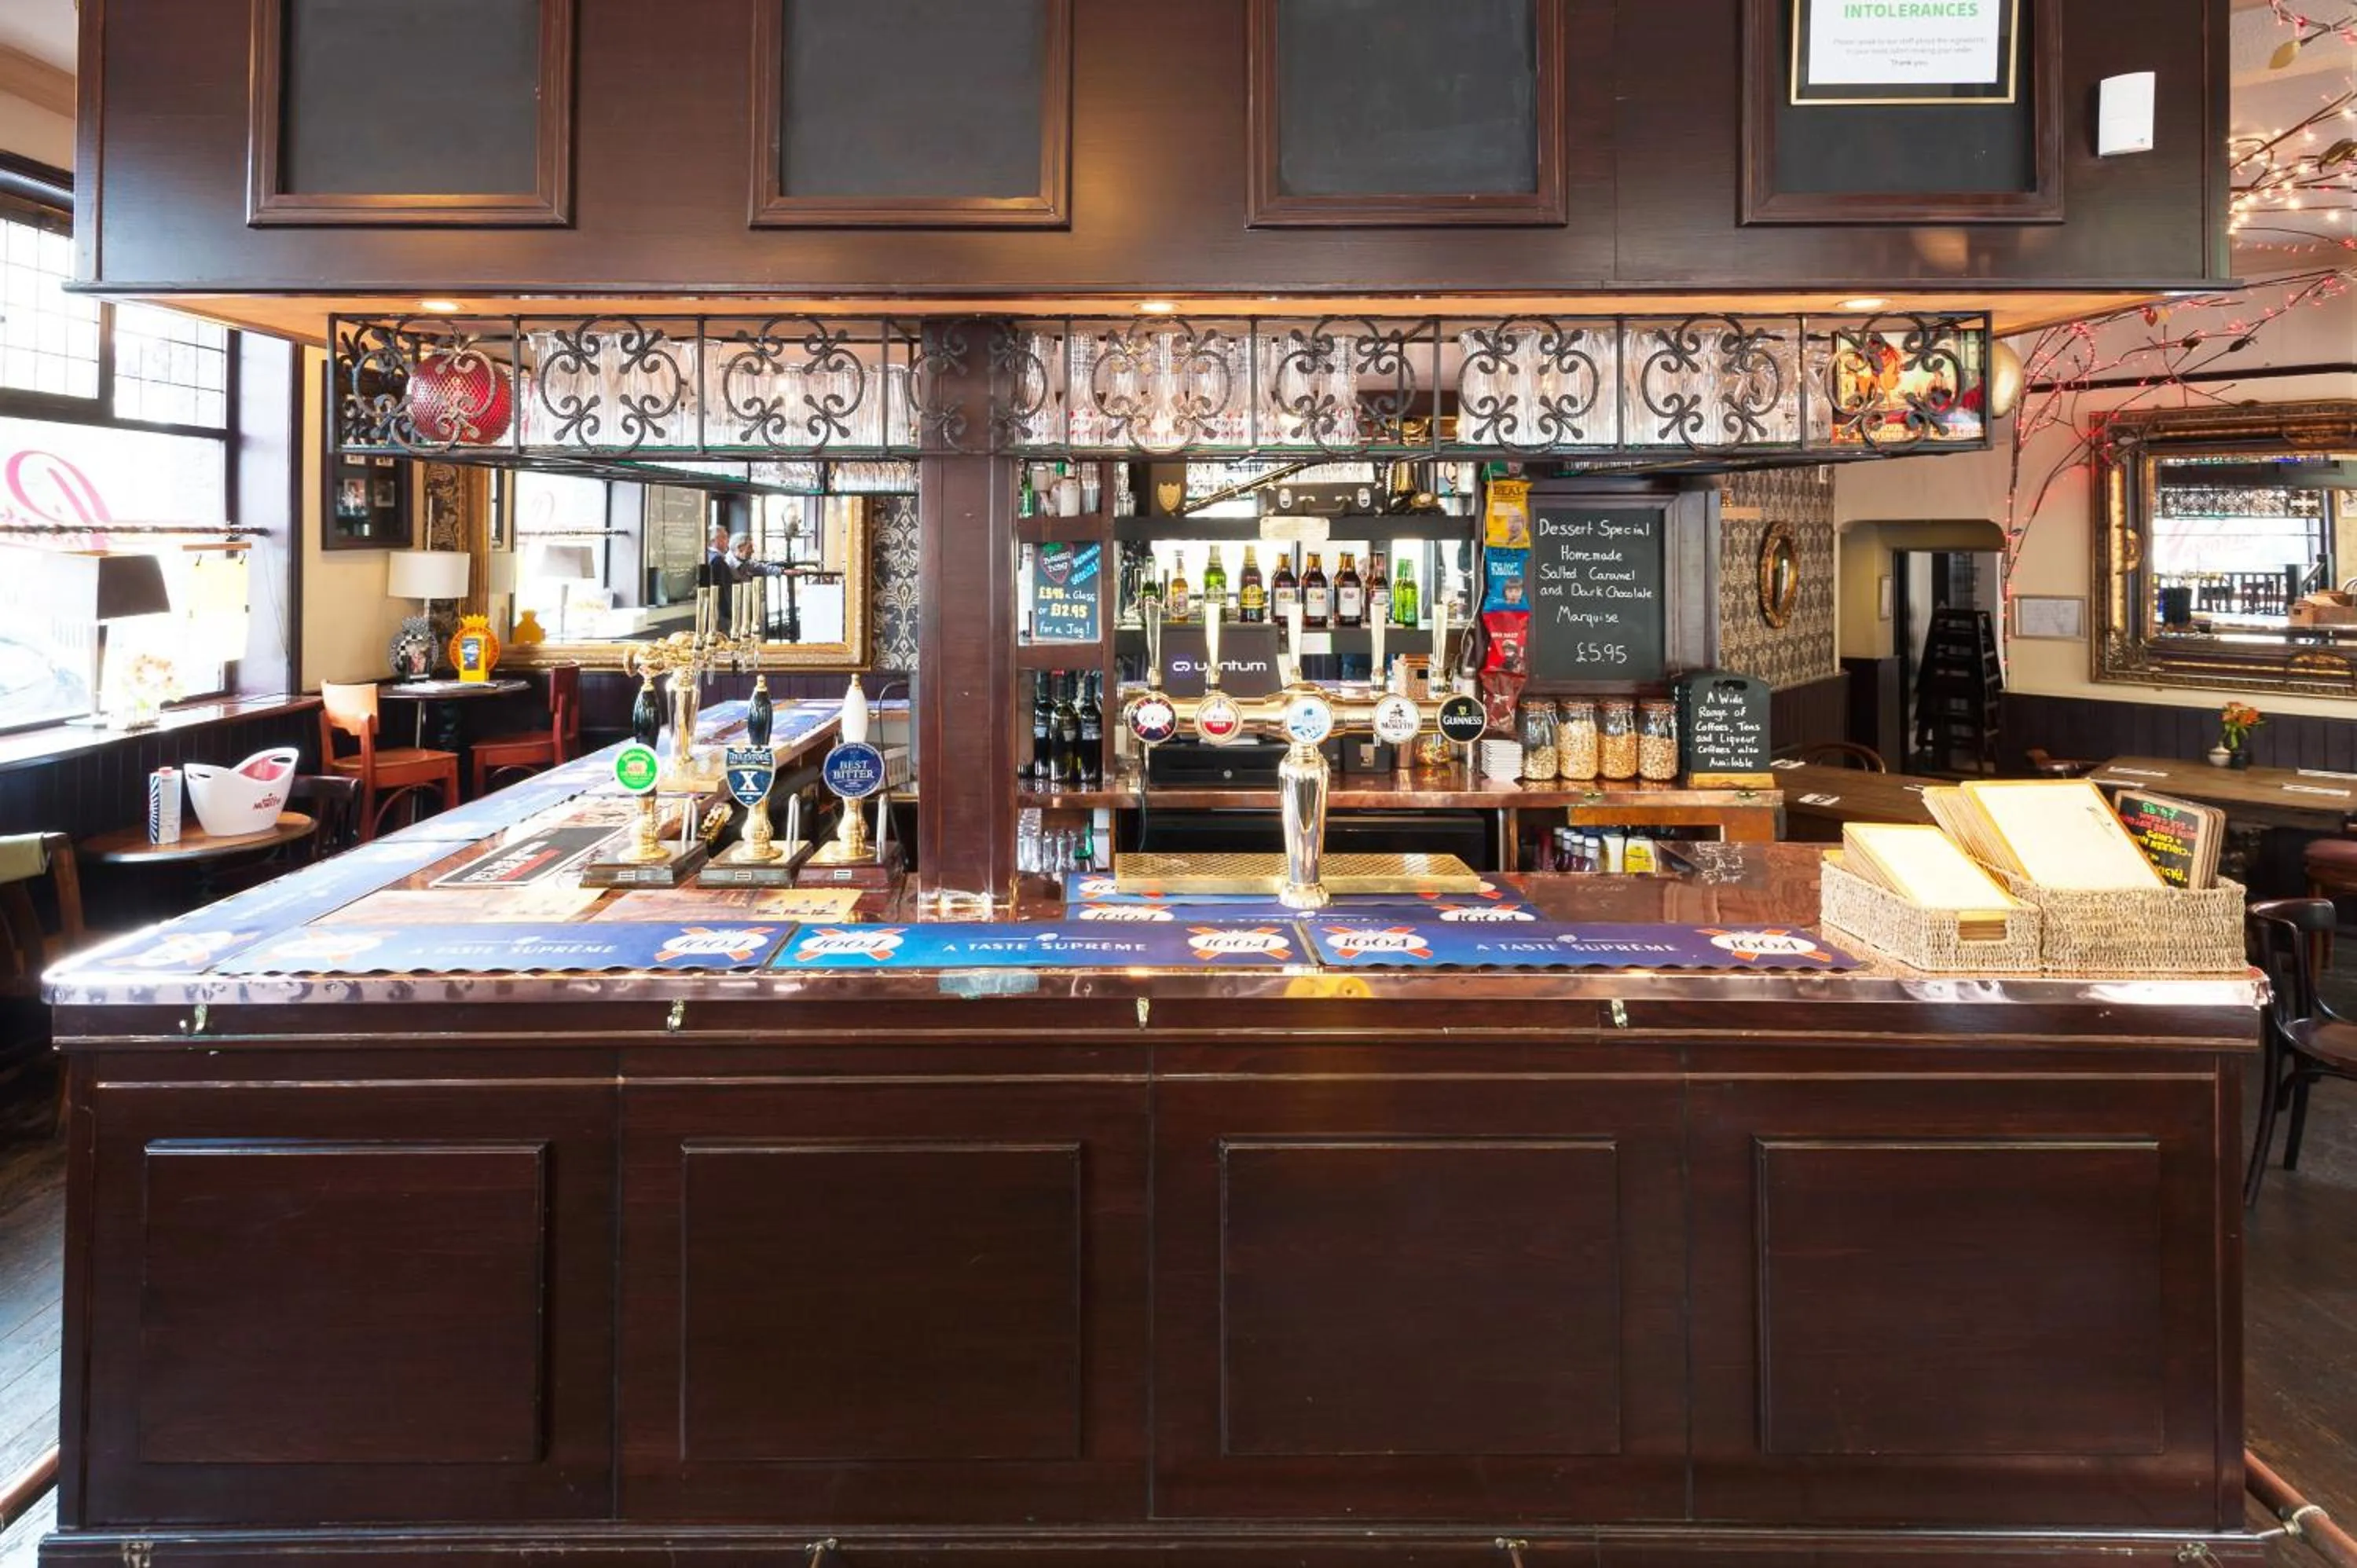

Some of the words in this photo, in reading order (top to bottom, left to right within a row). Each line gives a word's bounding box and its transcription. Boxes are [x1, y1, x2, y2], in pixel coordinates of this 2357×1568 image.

[1844, 2, 1978, 18] INTOLERANCES
[1538, 518, 1593, 537] Dessert
[1597, 519, 1650, 540] Special
[1560, 544, 1622, 562] Homemade
[1539, 563, 1577, 580] Salted
[1589, 566, 1635, 581] Caramel
[1072, 590, 1096, 603] Glass
[1540, 585, 1563, 597] and
[1571, 583, 1603, 597] Dark
[1606, 585, 1653, 599] Chocolate
[1556, 606, 1619, 628] Marquise
[1039, 620, 1054, 634] for
[1575, 642, 1627, 665] £5.95
[1172, 660, 1267, 672] Quntum
[1706, 691, 1715, 703] A
[1718, 692, 1743, 705] Wide
[1442, 715, 1483, 725] GUINNESS
[1698, 706, 1728, 722] Range
[1734, 706, 1747, 717] of
[1736, 721, 1761, 732] Teas
[1695, 733, 1713, 743] and
[1720, 733, 1758, 746] Liqueur
[1697, 745, 1731, 754] Coffees
[1737, 746, 1759, 754] also
[840, 760, 868, 769] BEST
[1709, 757, 1754, 768] Available
[833, 769, 874, 779] BITTER
